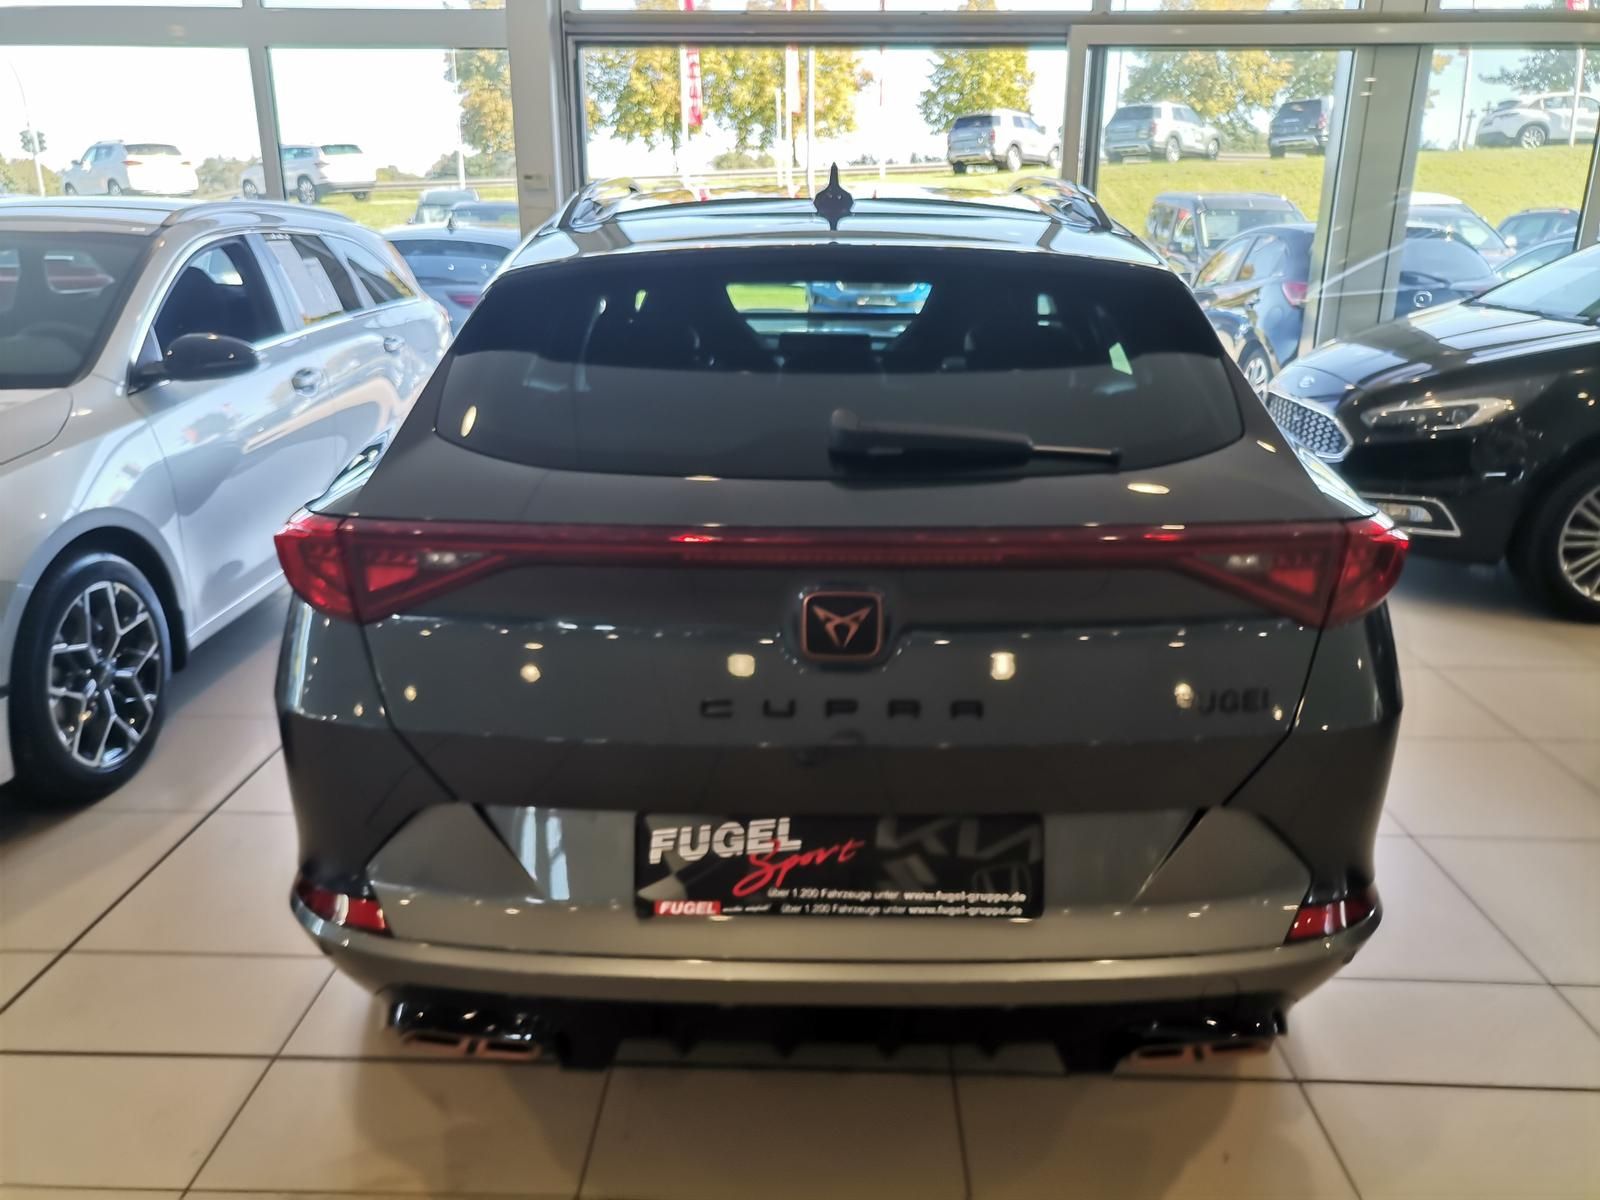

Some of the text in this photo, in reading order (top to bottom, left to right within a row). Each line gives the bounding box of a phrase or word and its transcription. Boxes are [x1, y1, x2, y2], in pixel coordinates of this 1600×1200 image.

[700, 697, 985, 719] CUPRA
[649, 817, 802, 865] FUGEL
[732, 838, 864, 897] Sport
[820, 888, 872, 902] Fahrzeuge
[873, 890, 900, 900] unter
[903, 889, 1027, 904] www.fugel-gruppe.de
[658, 901, 718, 915] FUGEL
[832, 903, 881, 916] Fahrzeuge
[907, 904, 1024, 917] www.fugel-gruppe.de
